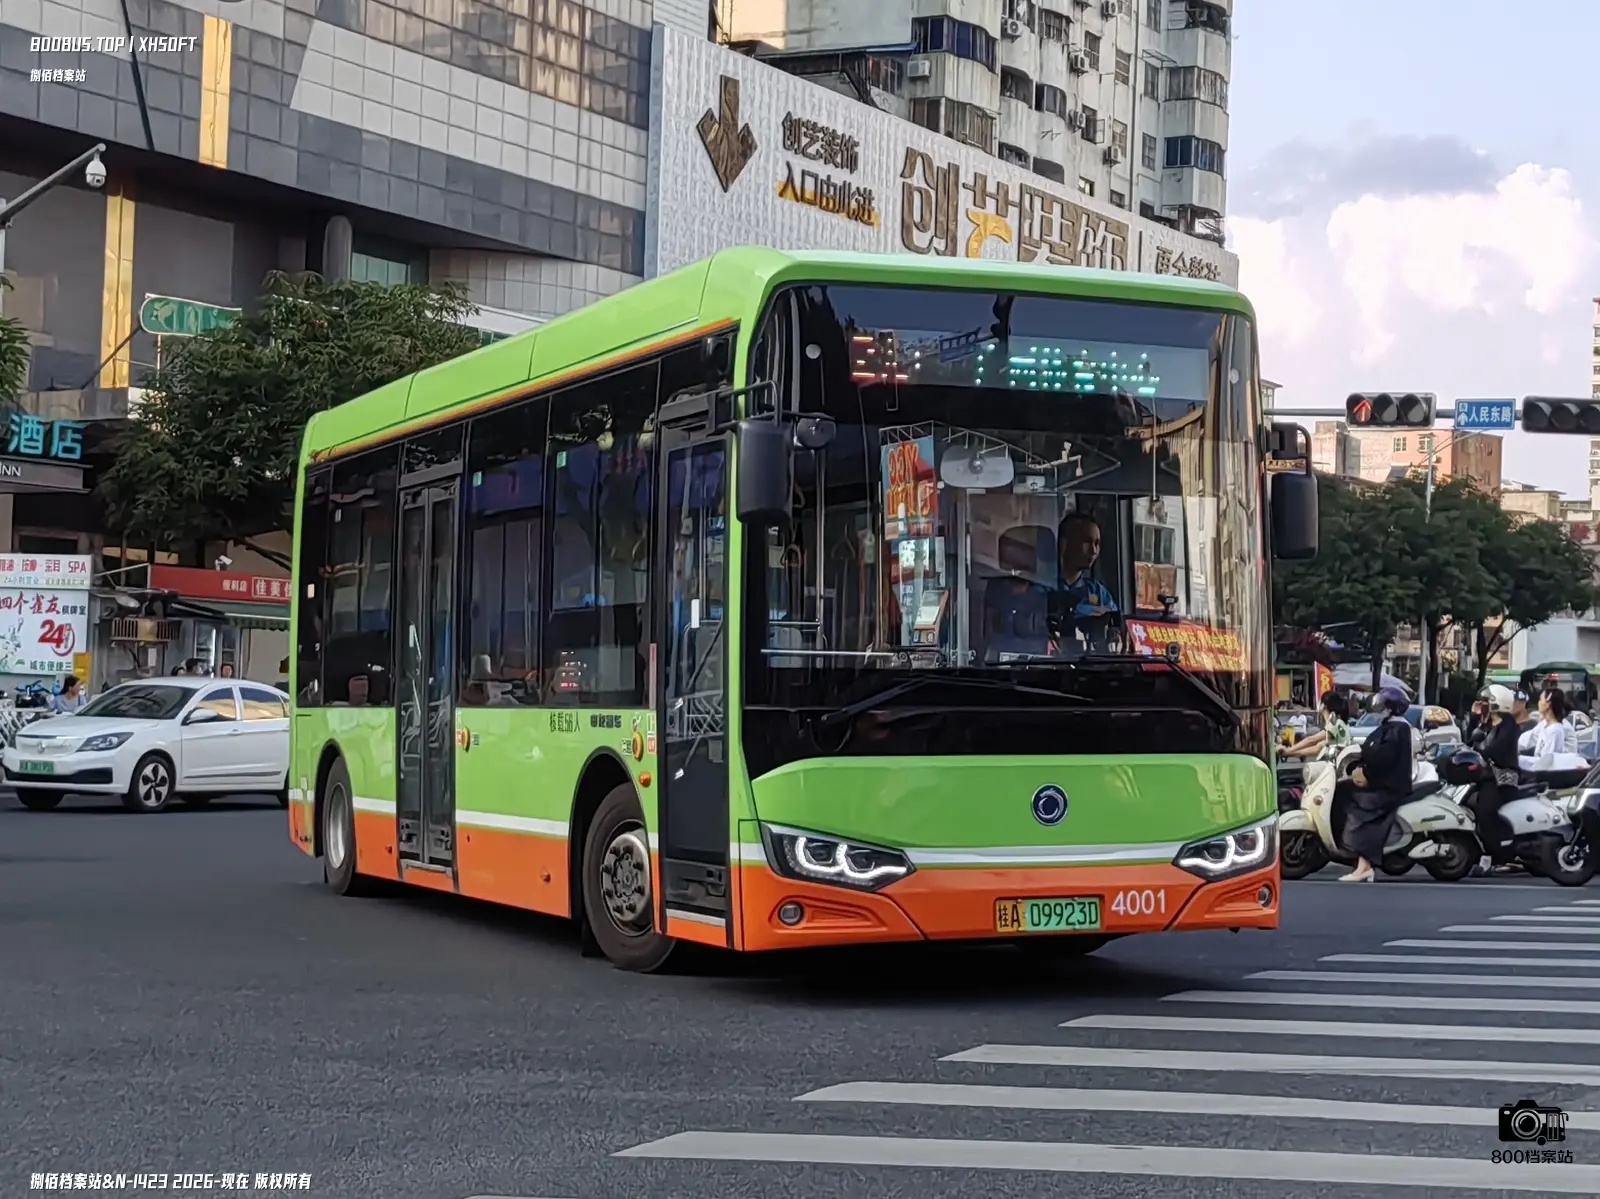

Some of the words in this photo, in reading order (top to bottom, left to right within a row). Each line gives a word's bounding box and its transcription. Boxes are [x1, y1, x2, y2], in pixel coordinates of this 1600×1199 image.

[781, 111, 860, 175] 创艺装饰
[778, 161, 876, 226] 入口由此进
[1469, 406, 1512, 423] 人民东路
[7, 413, 85, 460] 酒店
[68, 560, 87, 573] SPA
[1030, 901, 1099, 928] 09923D
[1111, 889, 1166, 916] 4001
